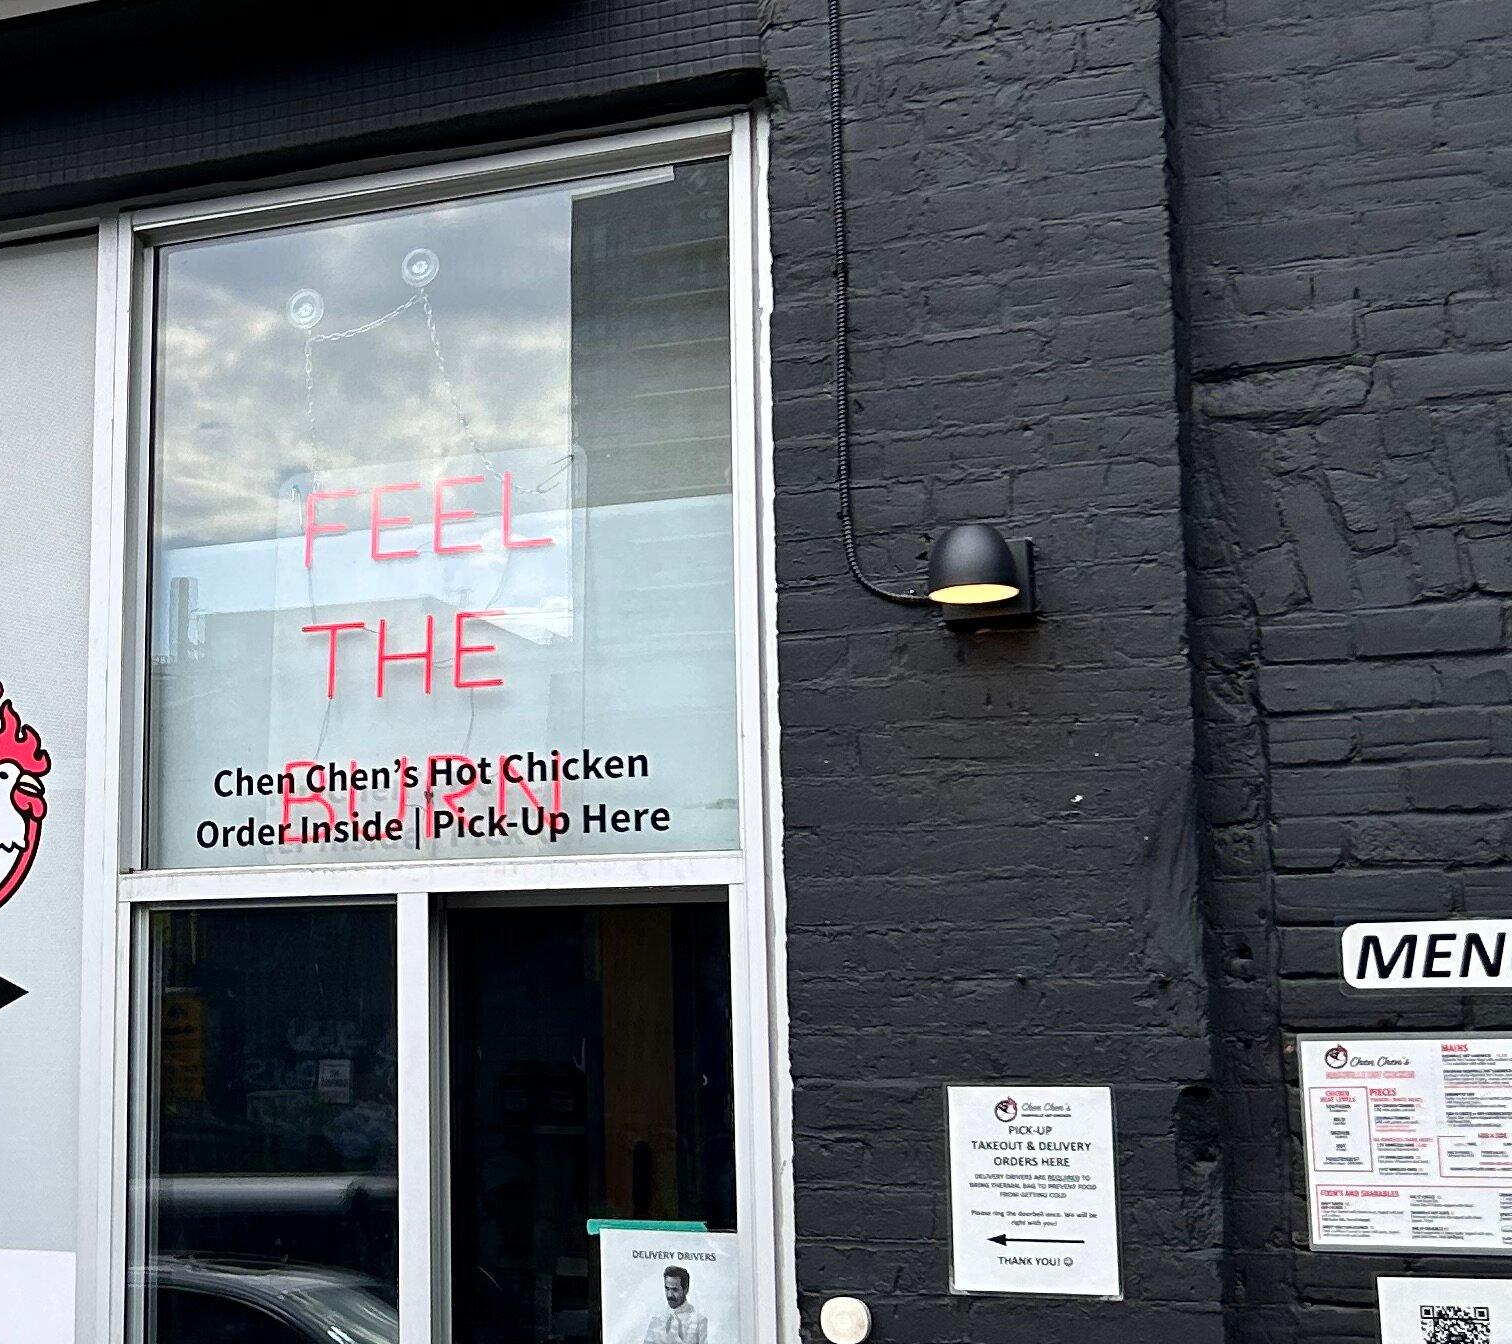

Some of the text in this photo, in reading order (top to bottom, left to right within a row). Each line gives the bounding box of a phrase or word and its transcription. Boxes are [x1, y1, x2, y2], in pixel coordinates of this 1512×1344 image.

[303, 470, 556, 570] FEEL
[301, 609, 506, 699] THE
[213, 747, 650, 799] Chen Chen's Hot Chicken
[281, 753, 564, 845] BURN
[195, 816, 293, 850] Order
[300, 810, 405, 845] Inside
[432, 805, 571, 844] Pick-Up
[582, 803, 671, 835] Here
[1369, 1088, 1397, 1096] PIECES
[1008, 1125, 1053, 1135] PICK-UP
[971, 1140, 1092, 1152] TAKEOUT & DELIVERY
[993, 1156, 1071, 1168] ORDERS HERE
[632, 1249, 717, 1262] DELIVERY DRIVERS
[997, 1256, 1061, 1267] THANK YOU!
